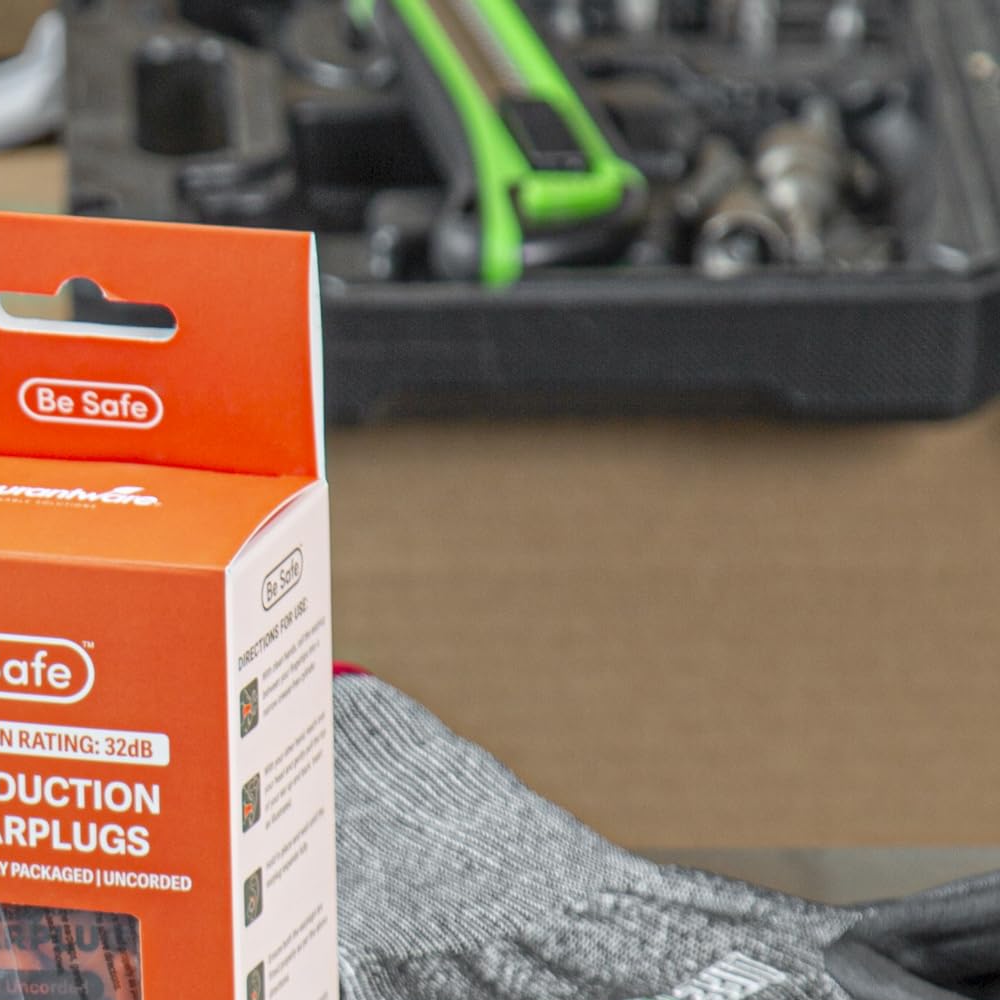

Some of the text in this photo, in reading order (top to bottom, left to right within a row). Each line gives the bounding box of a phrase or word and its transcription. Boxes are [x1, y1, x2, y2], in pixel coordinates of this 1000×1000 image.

[36, 388, 148, 420] Be Safe
[265, 559, 299, 602] Be Safe
[237, 624, 280, 671] DIRECTIONS
[280, 611, 294, 633] FOR
[18, 732, 101, 755] RATING:
[104, 738, 154, 758] 32dB
[10, 861, 94, 885] PACKAGED
[103, 870, 193, 892] UNCORDED
